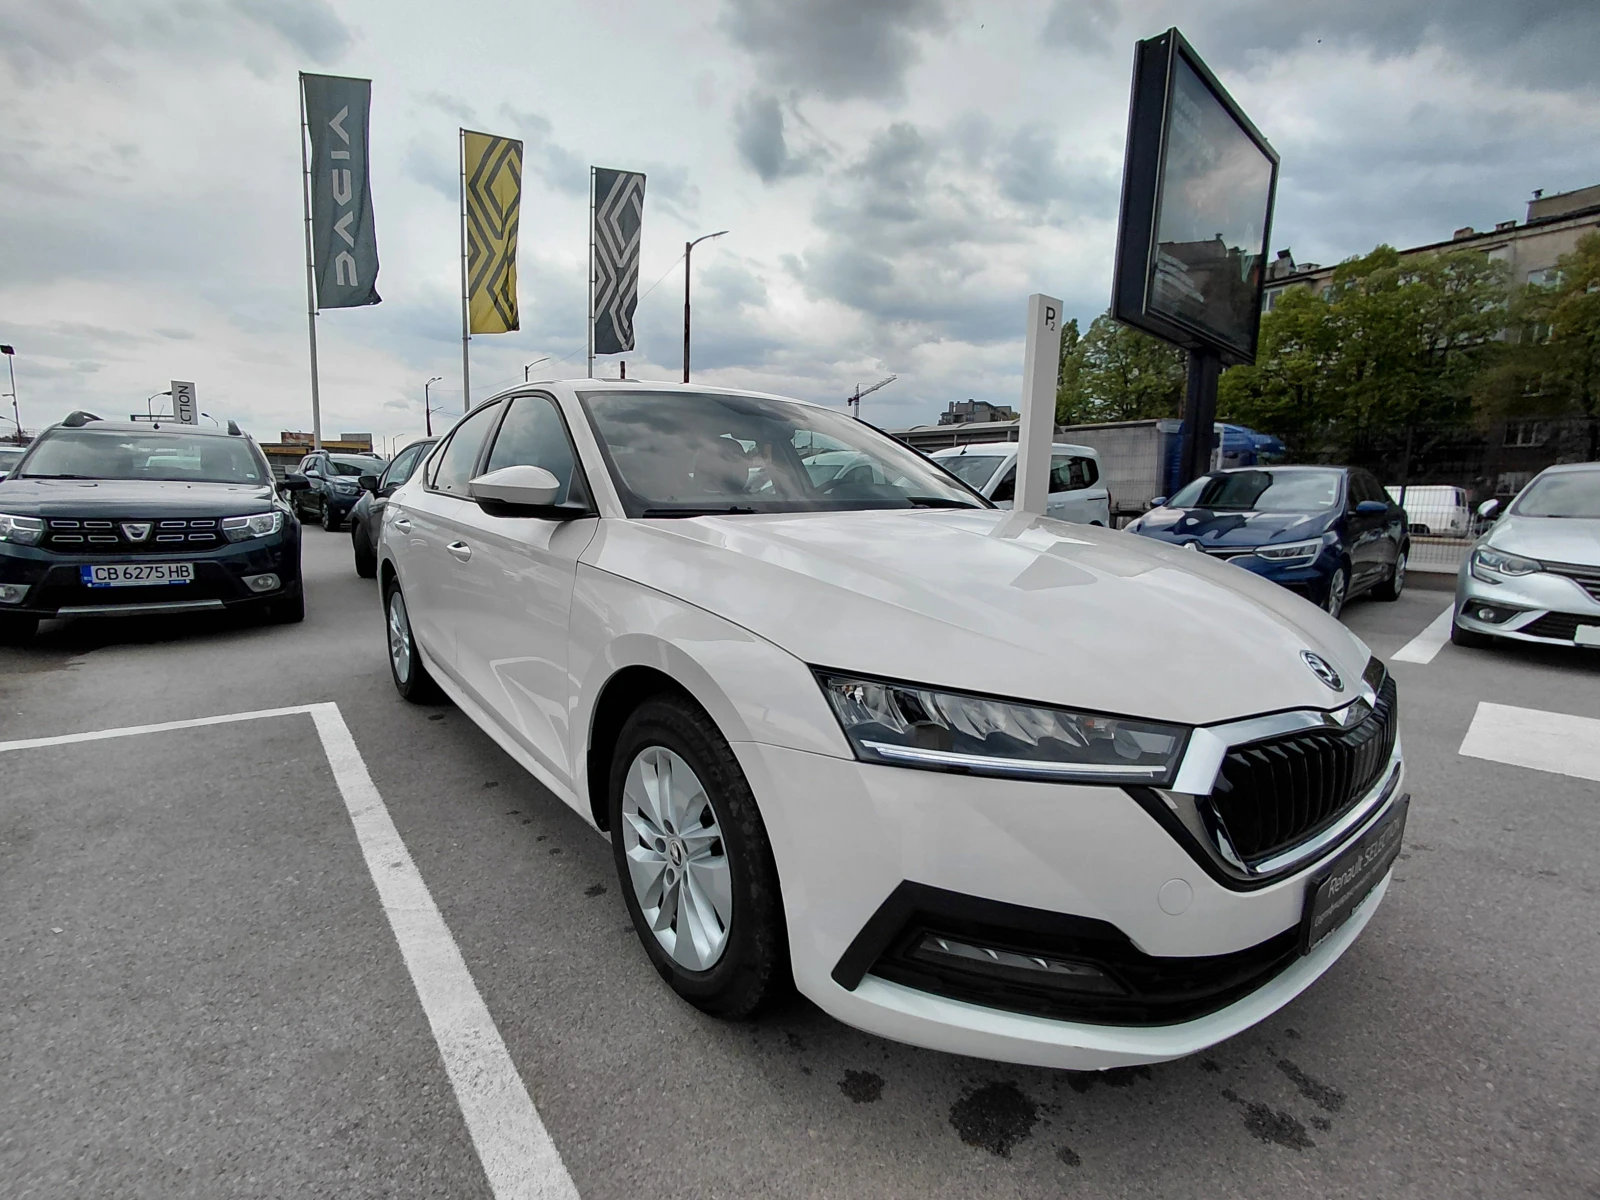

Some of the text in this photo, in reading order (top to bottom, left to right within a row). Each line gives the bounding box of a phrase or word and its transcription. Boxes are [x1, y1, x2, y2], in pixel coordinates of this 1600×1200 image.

[328, 105, 358, 287] DACIA
[95, 565, 191, 581] CB 6275 HB
[1328, 855, 1364, 898] Renault
